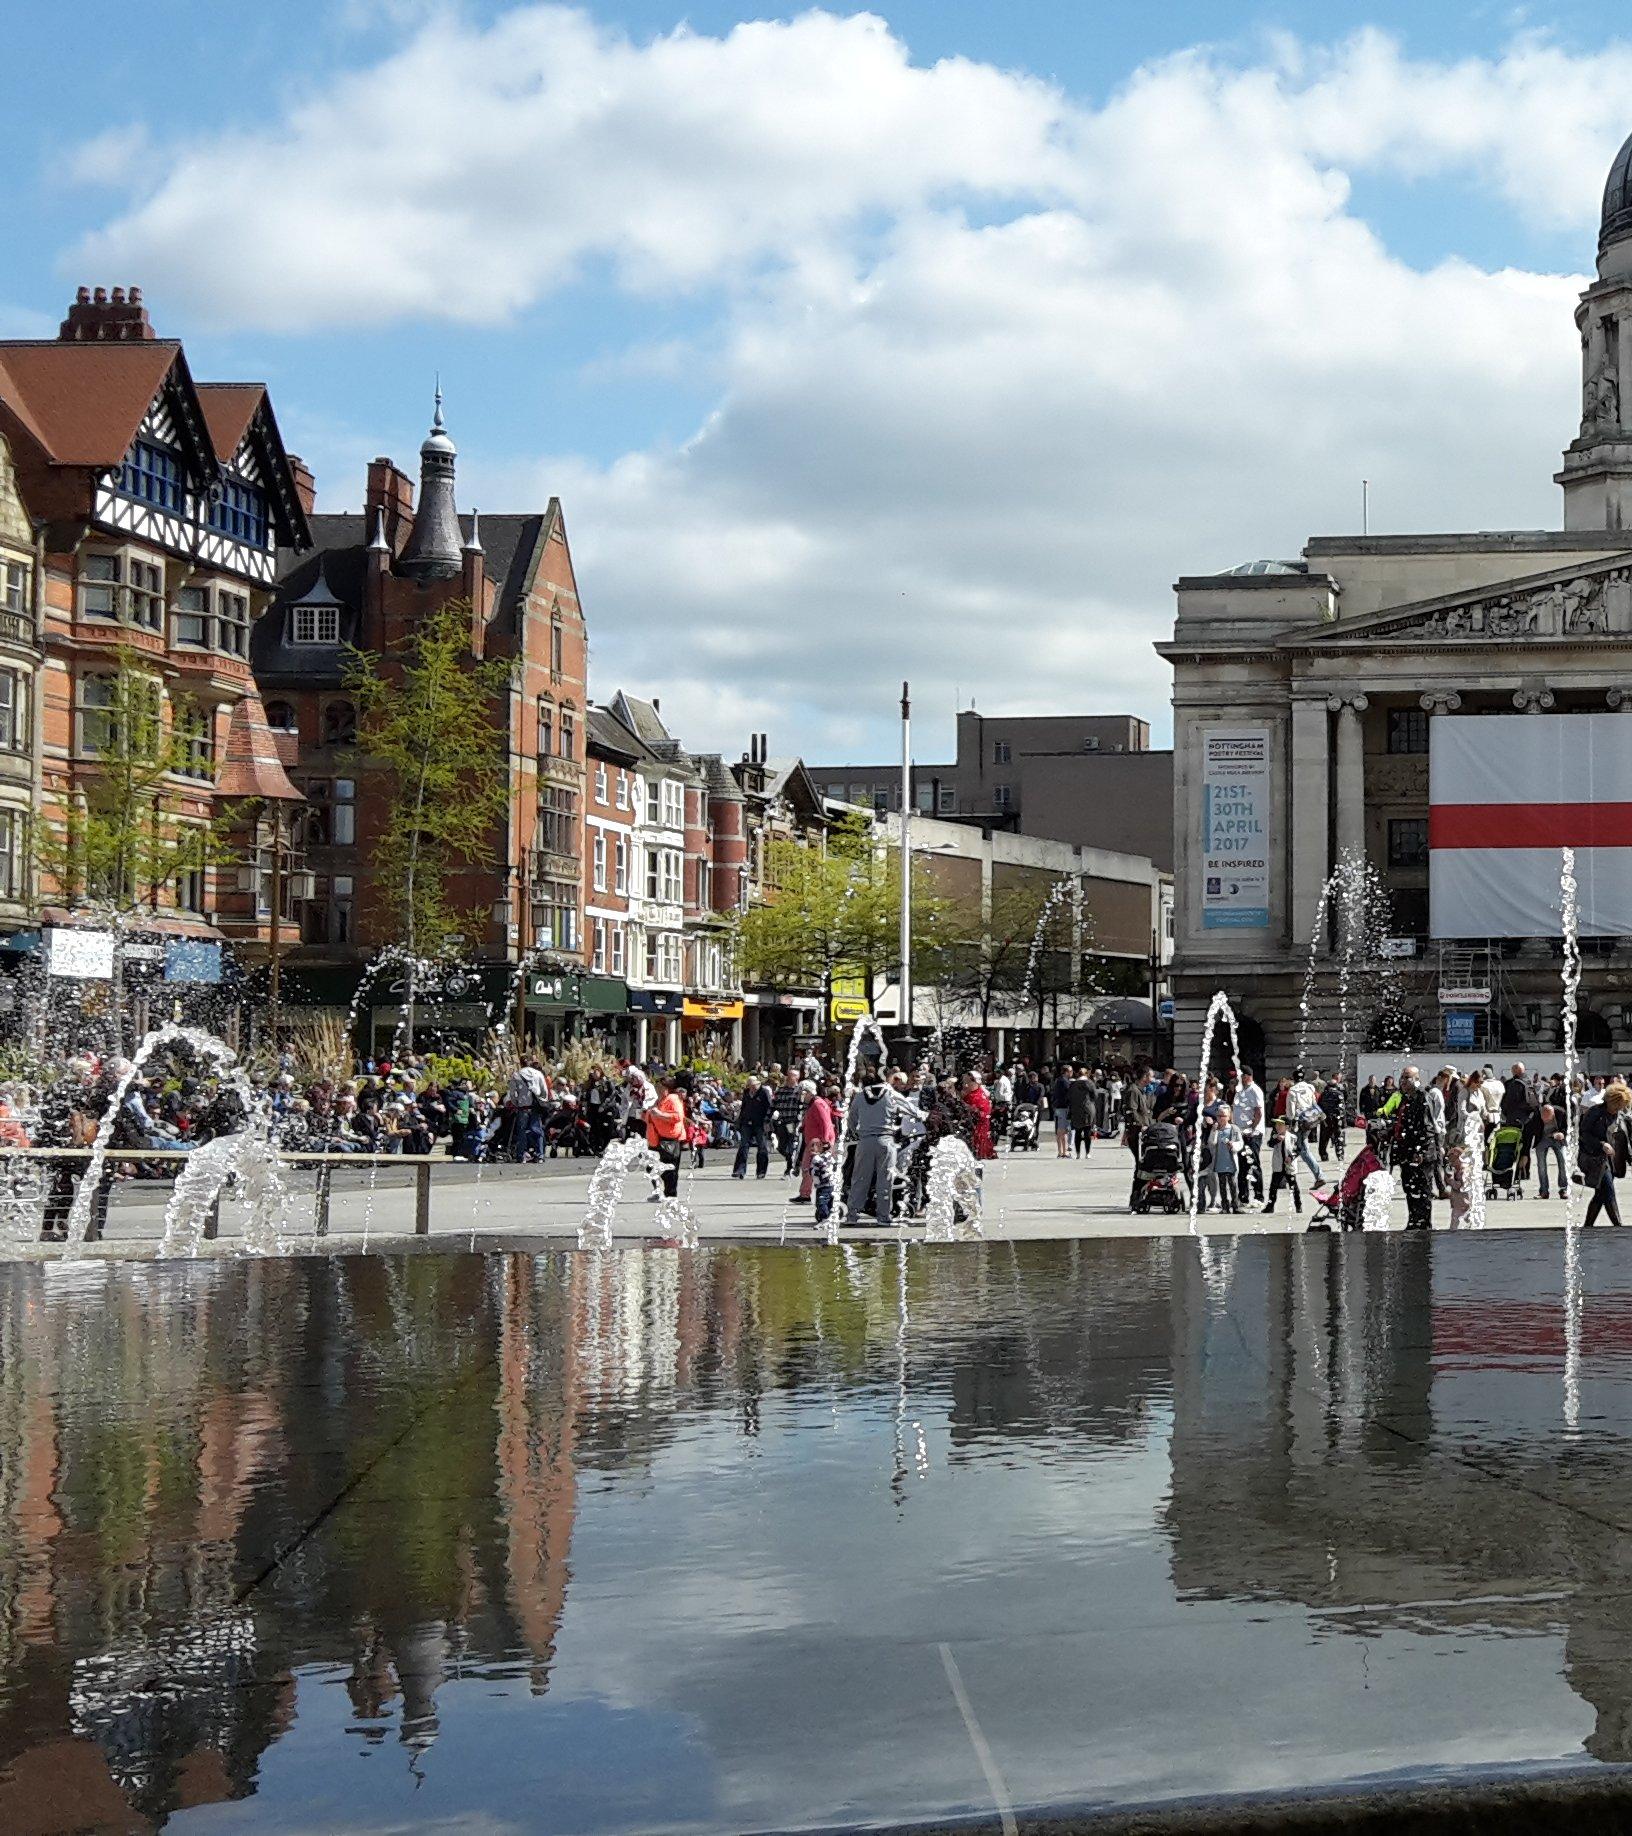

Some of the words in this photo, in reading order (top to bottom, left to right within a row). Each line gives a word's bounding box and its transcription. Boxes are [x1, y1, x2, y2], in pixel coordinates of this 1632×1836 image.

[1214, 785, 1252, 798] 21ST-
[1214, 802, 1253, 815] 30TH
[1213, 820, 1263, 833] APRIL
[1214, 837, 1249, 850] 2017
[1208, 860, 1219, 868] BE
[1222, 860, 1265, 868] INSPIRED
